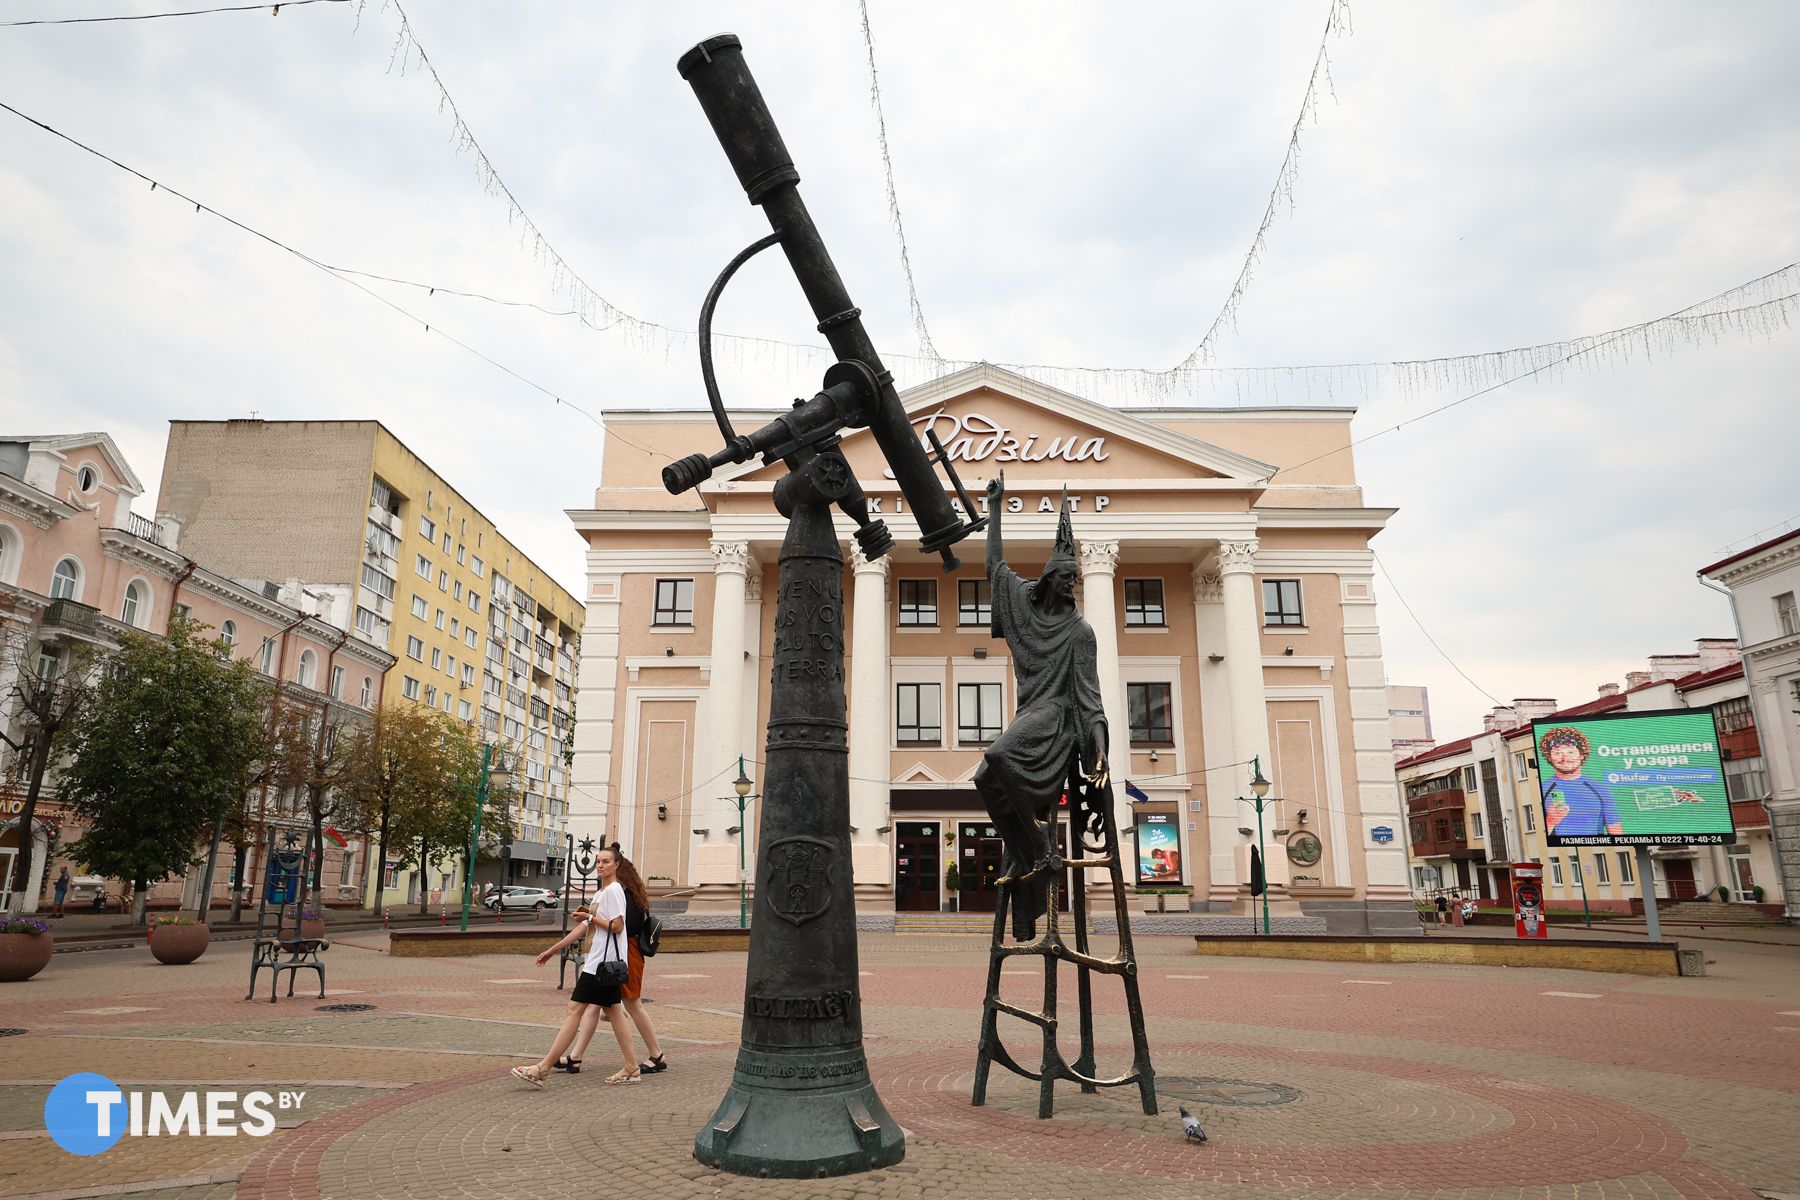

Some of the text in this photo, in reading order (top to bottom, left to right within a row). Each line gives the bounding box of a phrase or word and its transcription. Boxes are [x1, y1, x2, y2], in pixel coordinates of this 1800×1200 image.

[776, 659, 842, 682] TERRA
[1597, 742, 1714, 757] Остановился
[1636, 755, 1689, 768] озера
[1560, 835, 1722, 845] РАЗМЕЩЕНИЕ РЕКЛАМЫ 8 0222 76-40-24
